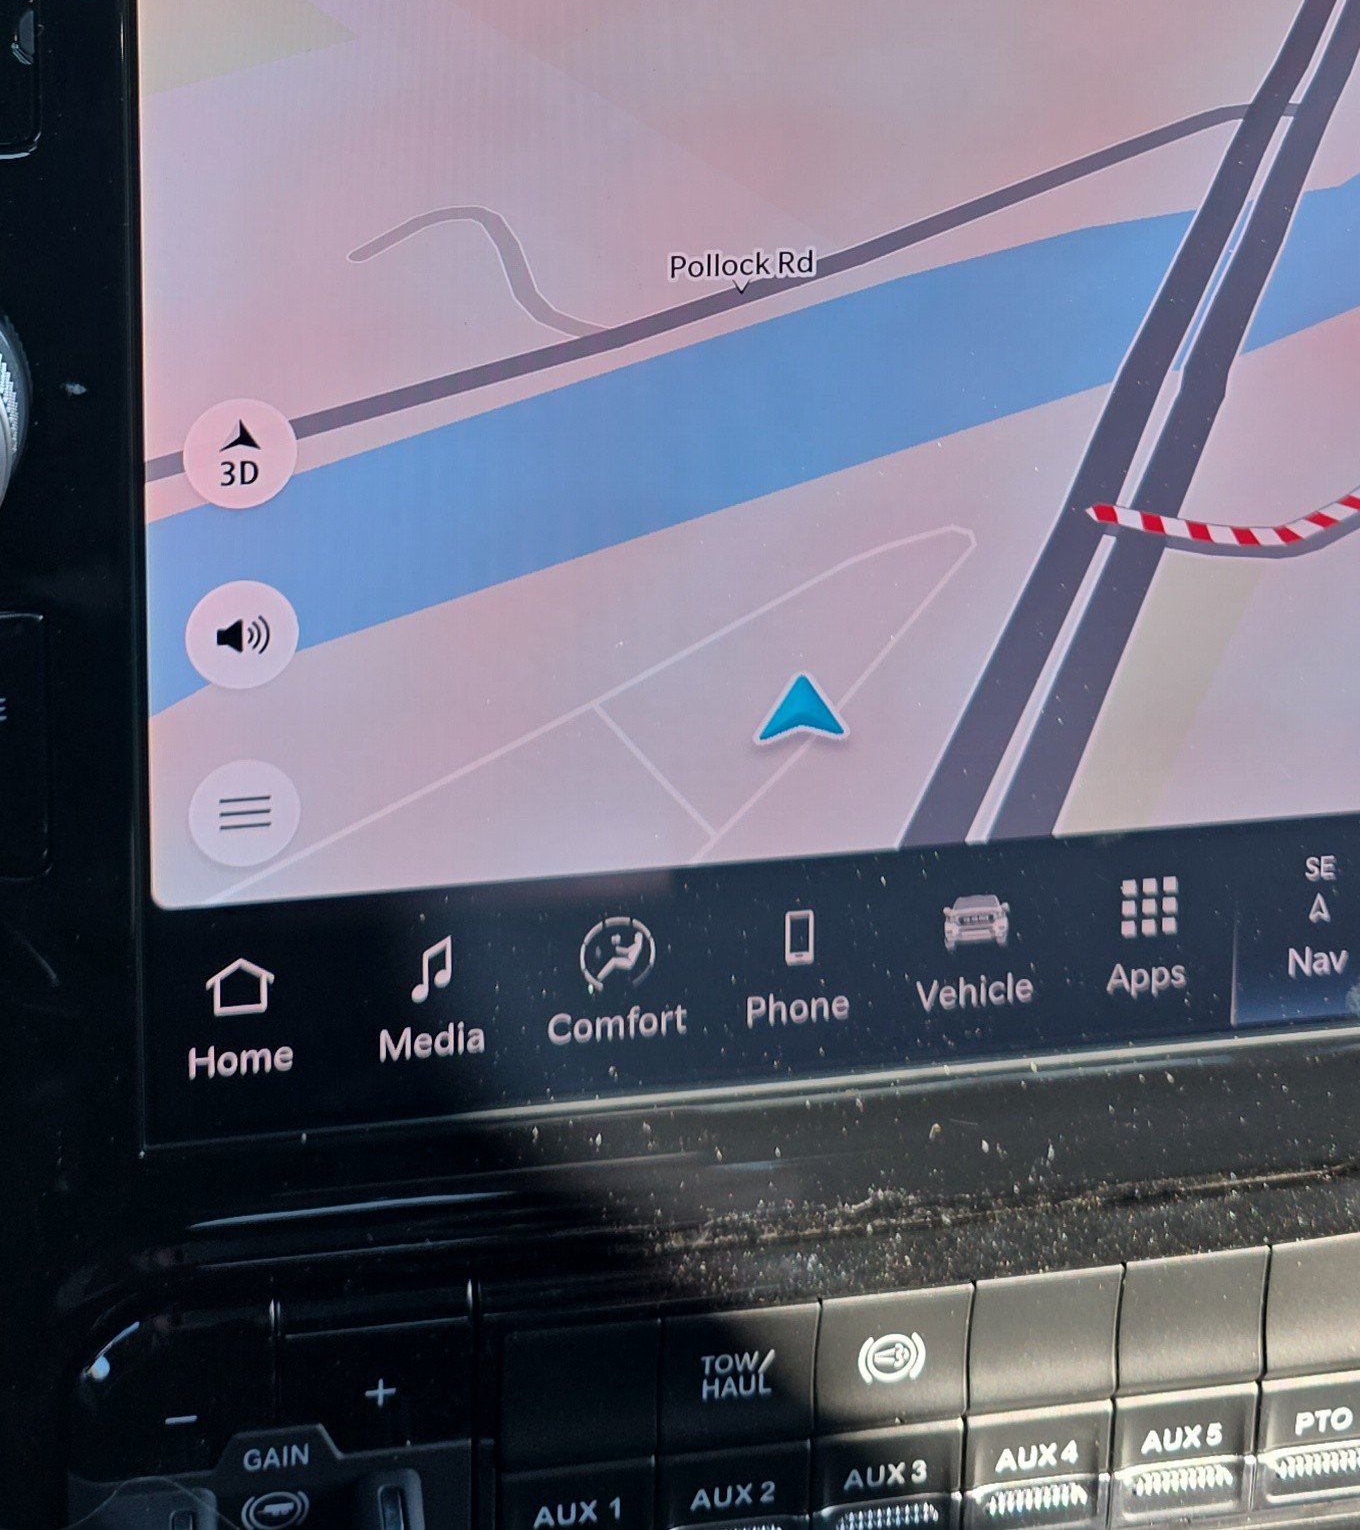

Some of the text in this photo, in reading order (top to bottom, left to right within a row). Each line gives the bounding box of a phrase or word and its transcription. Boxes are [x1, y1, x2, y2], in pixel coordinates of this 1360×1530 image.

[670, 249, 814, 279] Pollock Rd
[220, 460, 260, 486] 3D
[1304, 855, 1337, 881] SE
[1287, 947, 1348, 977] Nav
[915, 972, 1034, 1011] Vehicle
[1106, 963, 1186, 998] Apps
[547, 1004, 687, 1045] Comfort
[746, 992, 850, 1027] Phone
[378, 1021, 486, 1064] Media
[187, 1042, 294, 1081] Home
[701, 1348, 776, 1375] TOW/
[701, 1373, 772, 1403] HAUL
[1294, 1407, 1354, 1435] PTO
[1141, 1422, 1223, 1455] AUX 5
[243, 1442, 310, 1472] GAIN
[994, 1439, 1079, 1473] AUX 4
[843, 1459, 928, 1491] AUX 3
[689, 1481, 776, 1512] AUX 2
[533, 1497, 622, 1529] AUX 1
